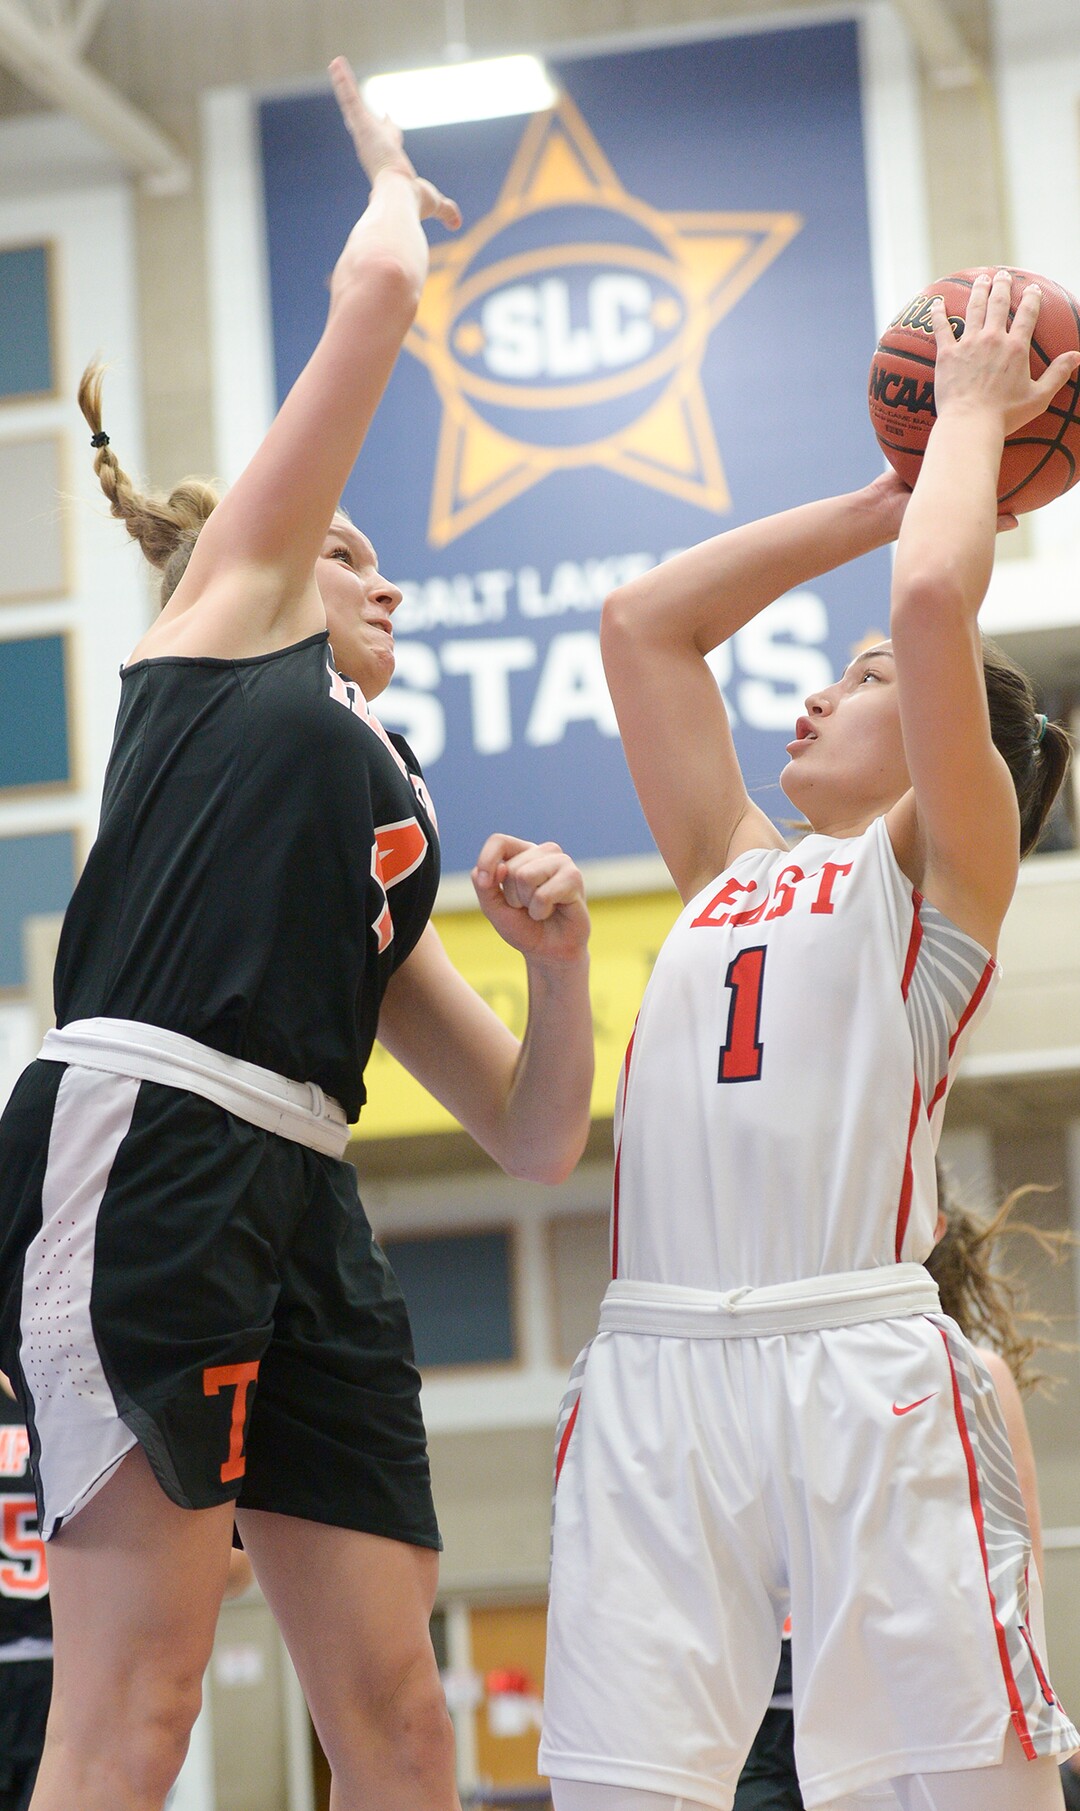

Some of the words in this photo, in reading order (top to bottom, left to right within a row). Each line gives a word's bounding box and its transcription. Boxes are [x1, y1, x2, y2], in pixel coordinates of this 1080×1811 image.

[482, 273, 654, 378] SLC
[869, 364, 938, 417] NCAA
[394, 568, 512, 634] SALT
[366, 587, 834, 772] STAS
[717, 944, 768, 1084] 1
[203, 1360, 260, 1484] T
